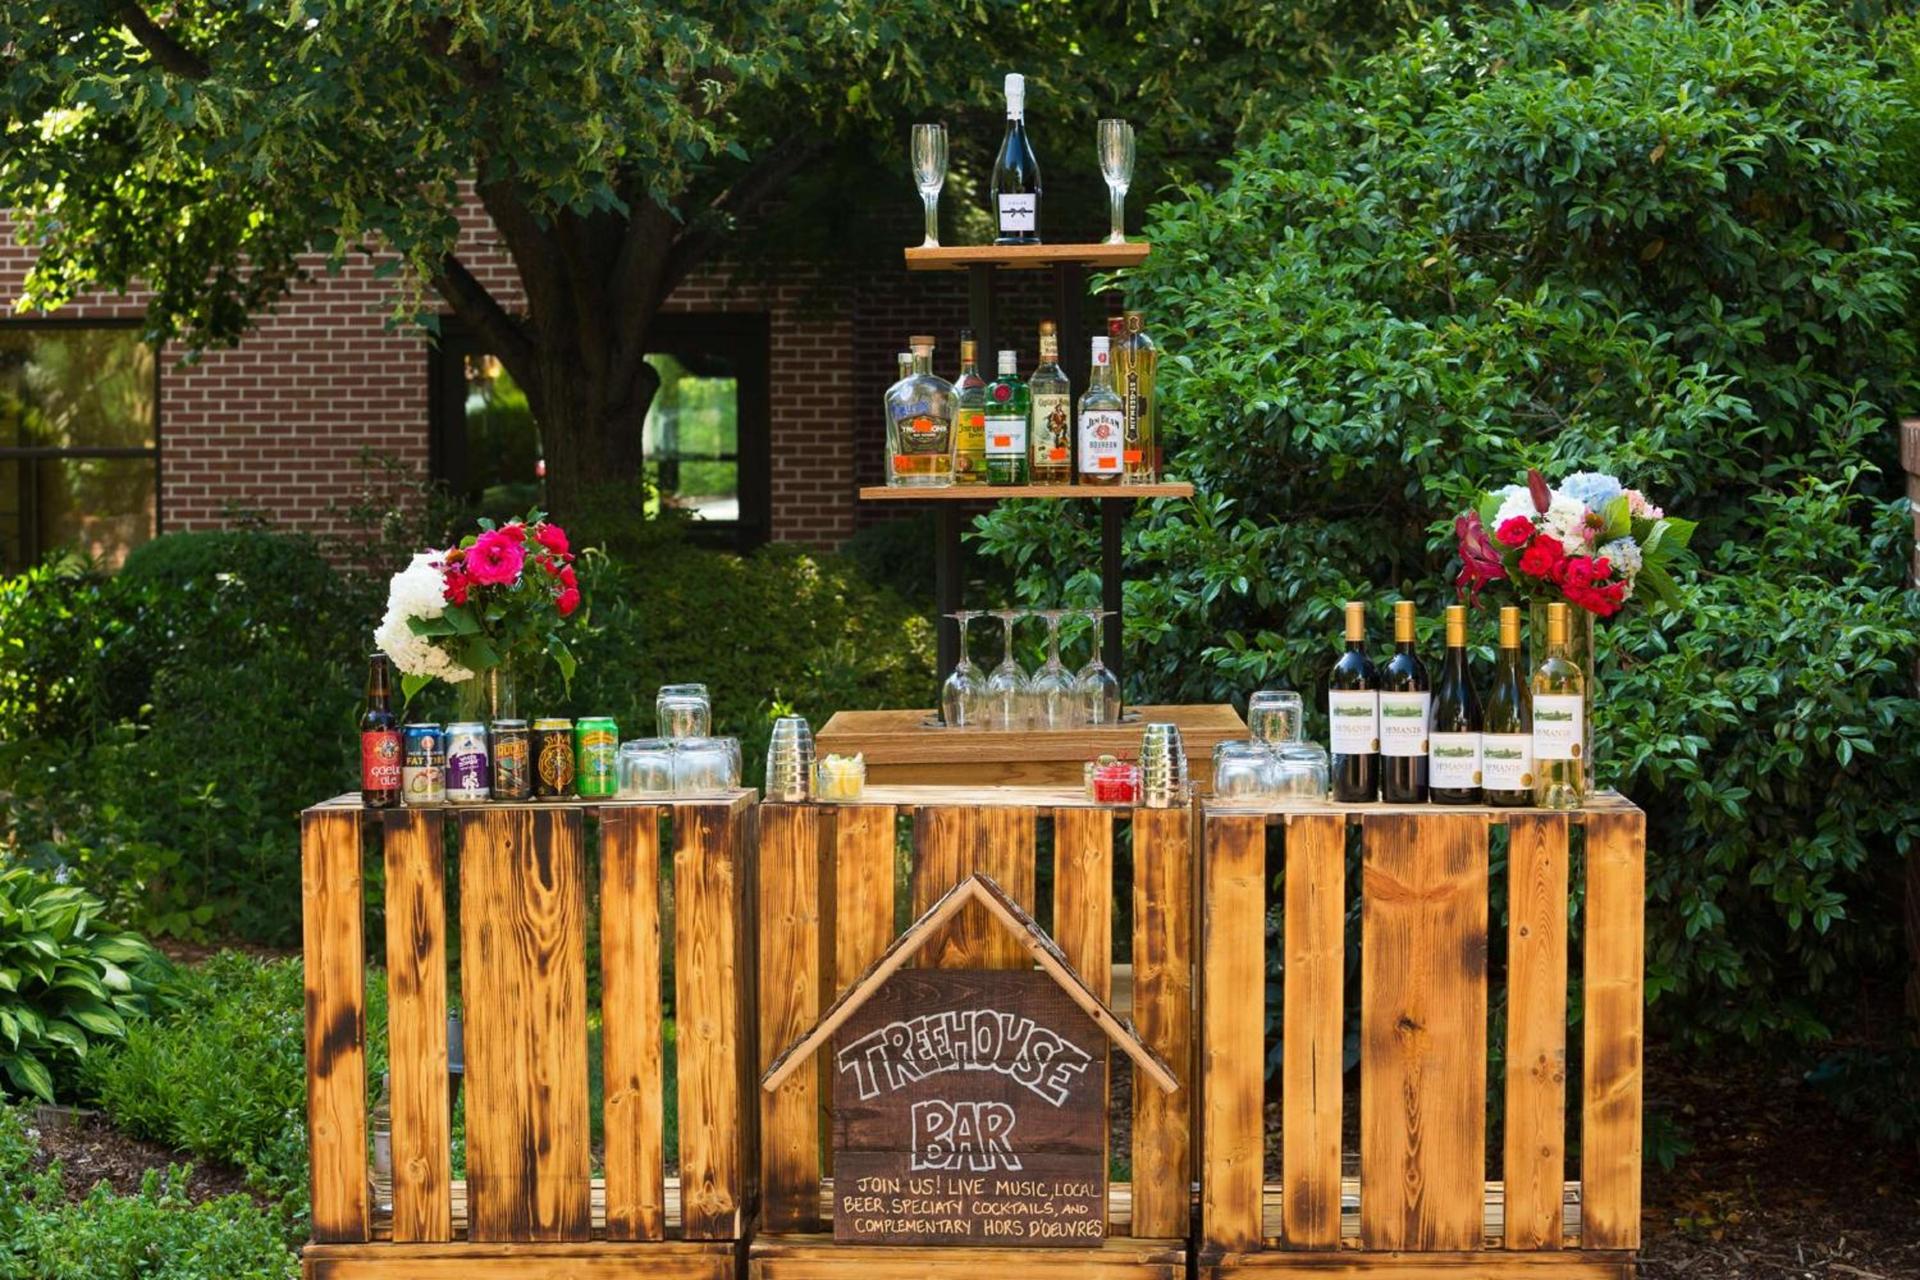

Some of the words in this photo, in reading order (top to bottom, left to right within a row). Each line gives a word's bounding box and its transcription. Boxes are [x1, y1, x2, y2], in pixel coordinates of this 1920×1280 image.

[406, 757, 424, 766] FAT
[380, 774, 397, 786] ale
[837, 1008, 1093, 1108] TREEHOUSE
[910, 1099, 1023, 1172] BAR
[856, 1176, 900, 1194] JOIN
[909, 1174, 941, 1195] US!
[948, 1177, 985, 1195] LIVE
[971, 1201, 1058, 1217] COCKTAILS,
[1061, 1204, 1089, 1215] AND
[854, 1218, 971, 1236] COMPLEMENTARY
[983, 1219, 1025, 1237] HORS
[1028, 1218, 1103, 1238] D'OEUVRES
